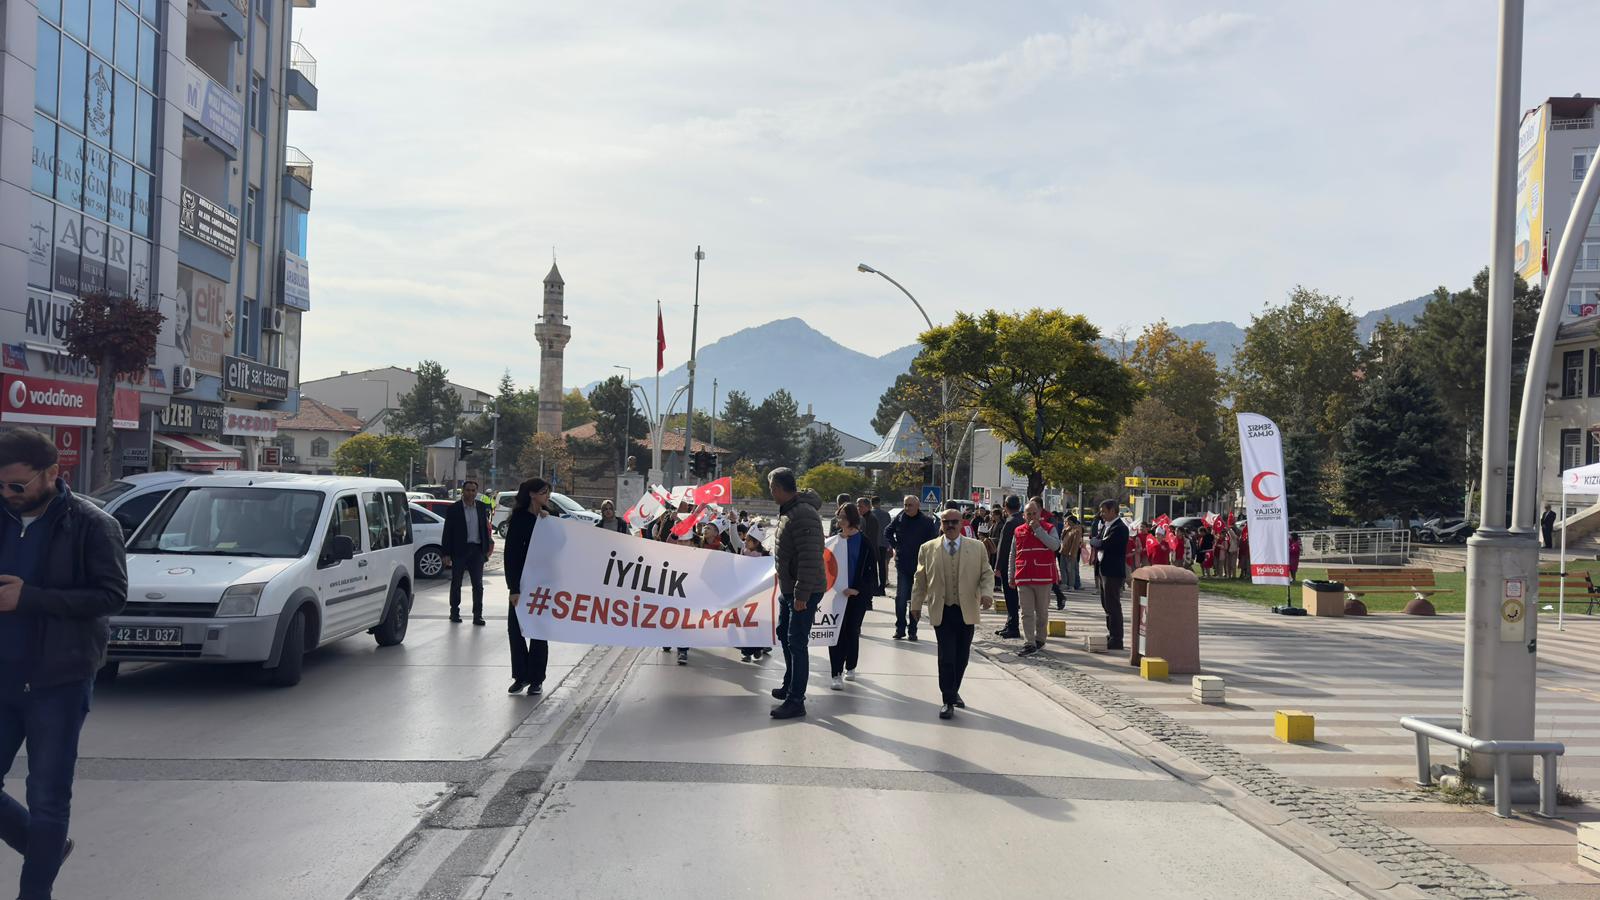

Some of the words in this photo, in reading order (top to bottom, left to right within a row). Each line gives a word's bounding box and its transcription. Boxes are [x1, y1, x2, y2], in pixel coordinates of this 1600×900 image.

[76, 143, 119, 178] AVUKT
[74, 168, 108, 198] SĞIN
[228, 361, 249, 389] elit
[29, 388, 83, 408] vodafone
[603, 550, 689, 599] İYİLİK
[526, 586, 759, 630] #SENSİZOLMAZ
[117, 629, 130, 641] 42
[136, 629, 149, 641] EJ
[155, 629, 175, 641] 037
